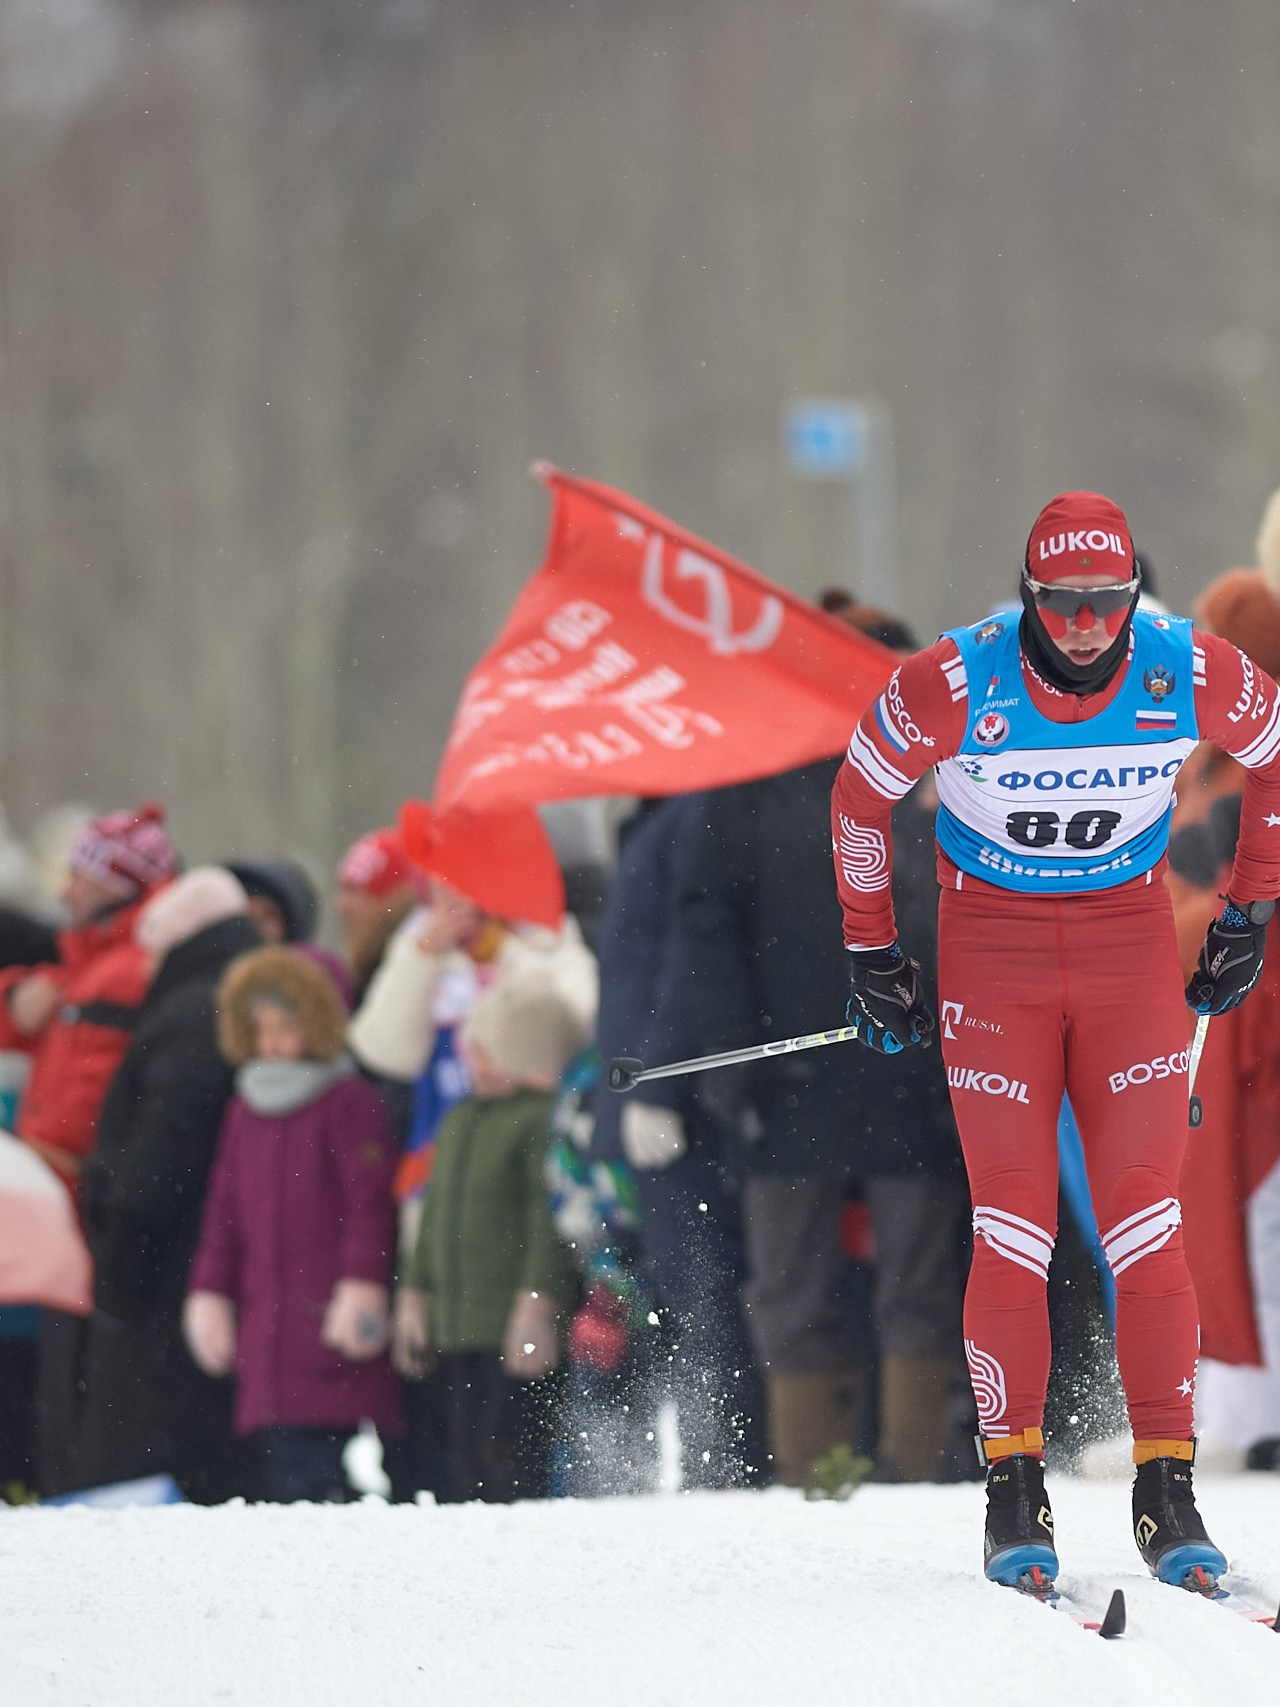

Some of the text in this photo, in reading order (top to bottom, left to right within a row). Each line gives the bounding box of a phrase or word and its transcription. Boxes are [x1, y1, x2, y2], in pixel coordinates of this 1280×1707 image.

[1040, 530, 1126, 560] LUKOIL
[998, 758, 1184, 791] ФОСАГРО
[964, 1016, 1004, 1035] RUSAL
[947, 1065, 1030, 1105] LUKOIL
[1108, 1051, 1189, 1094] BOSCO
